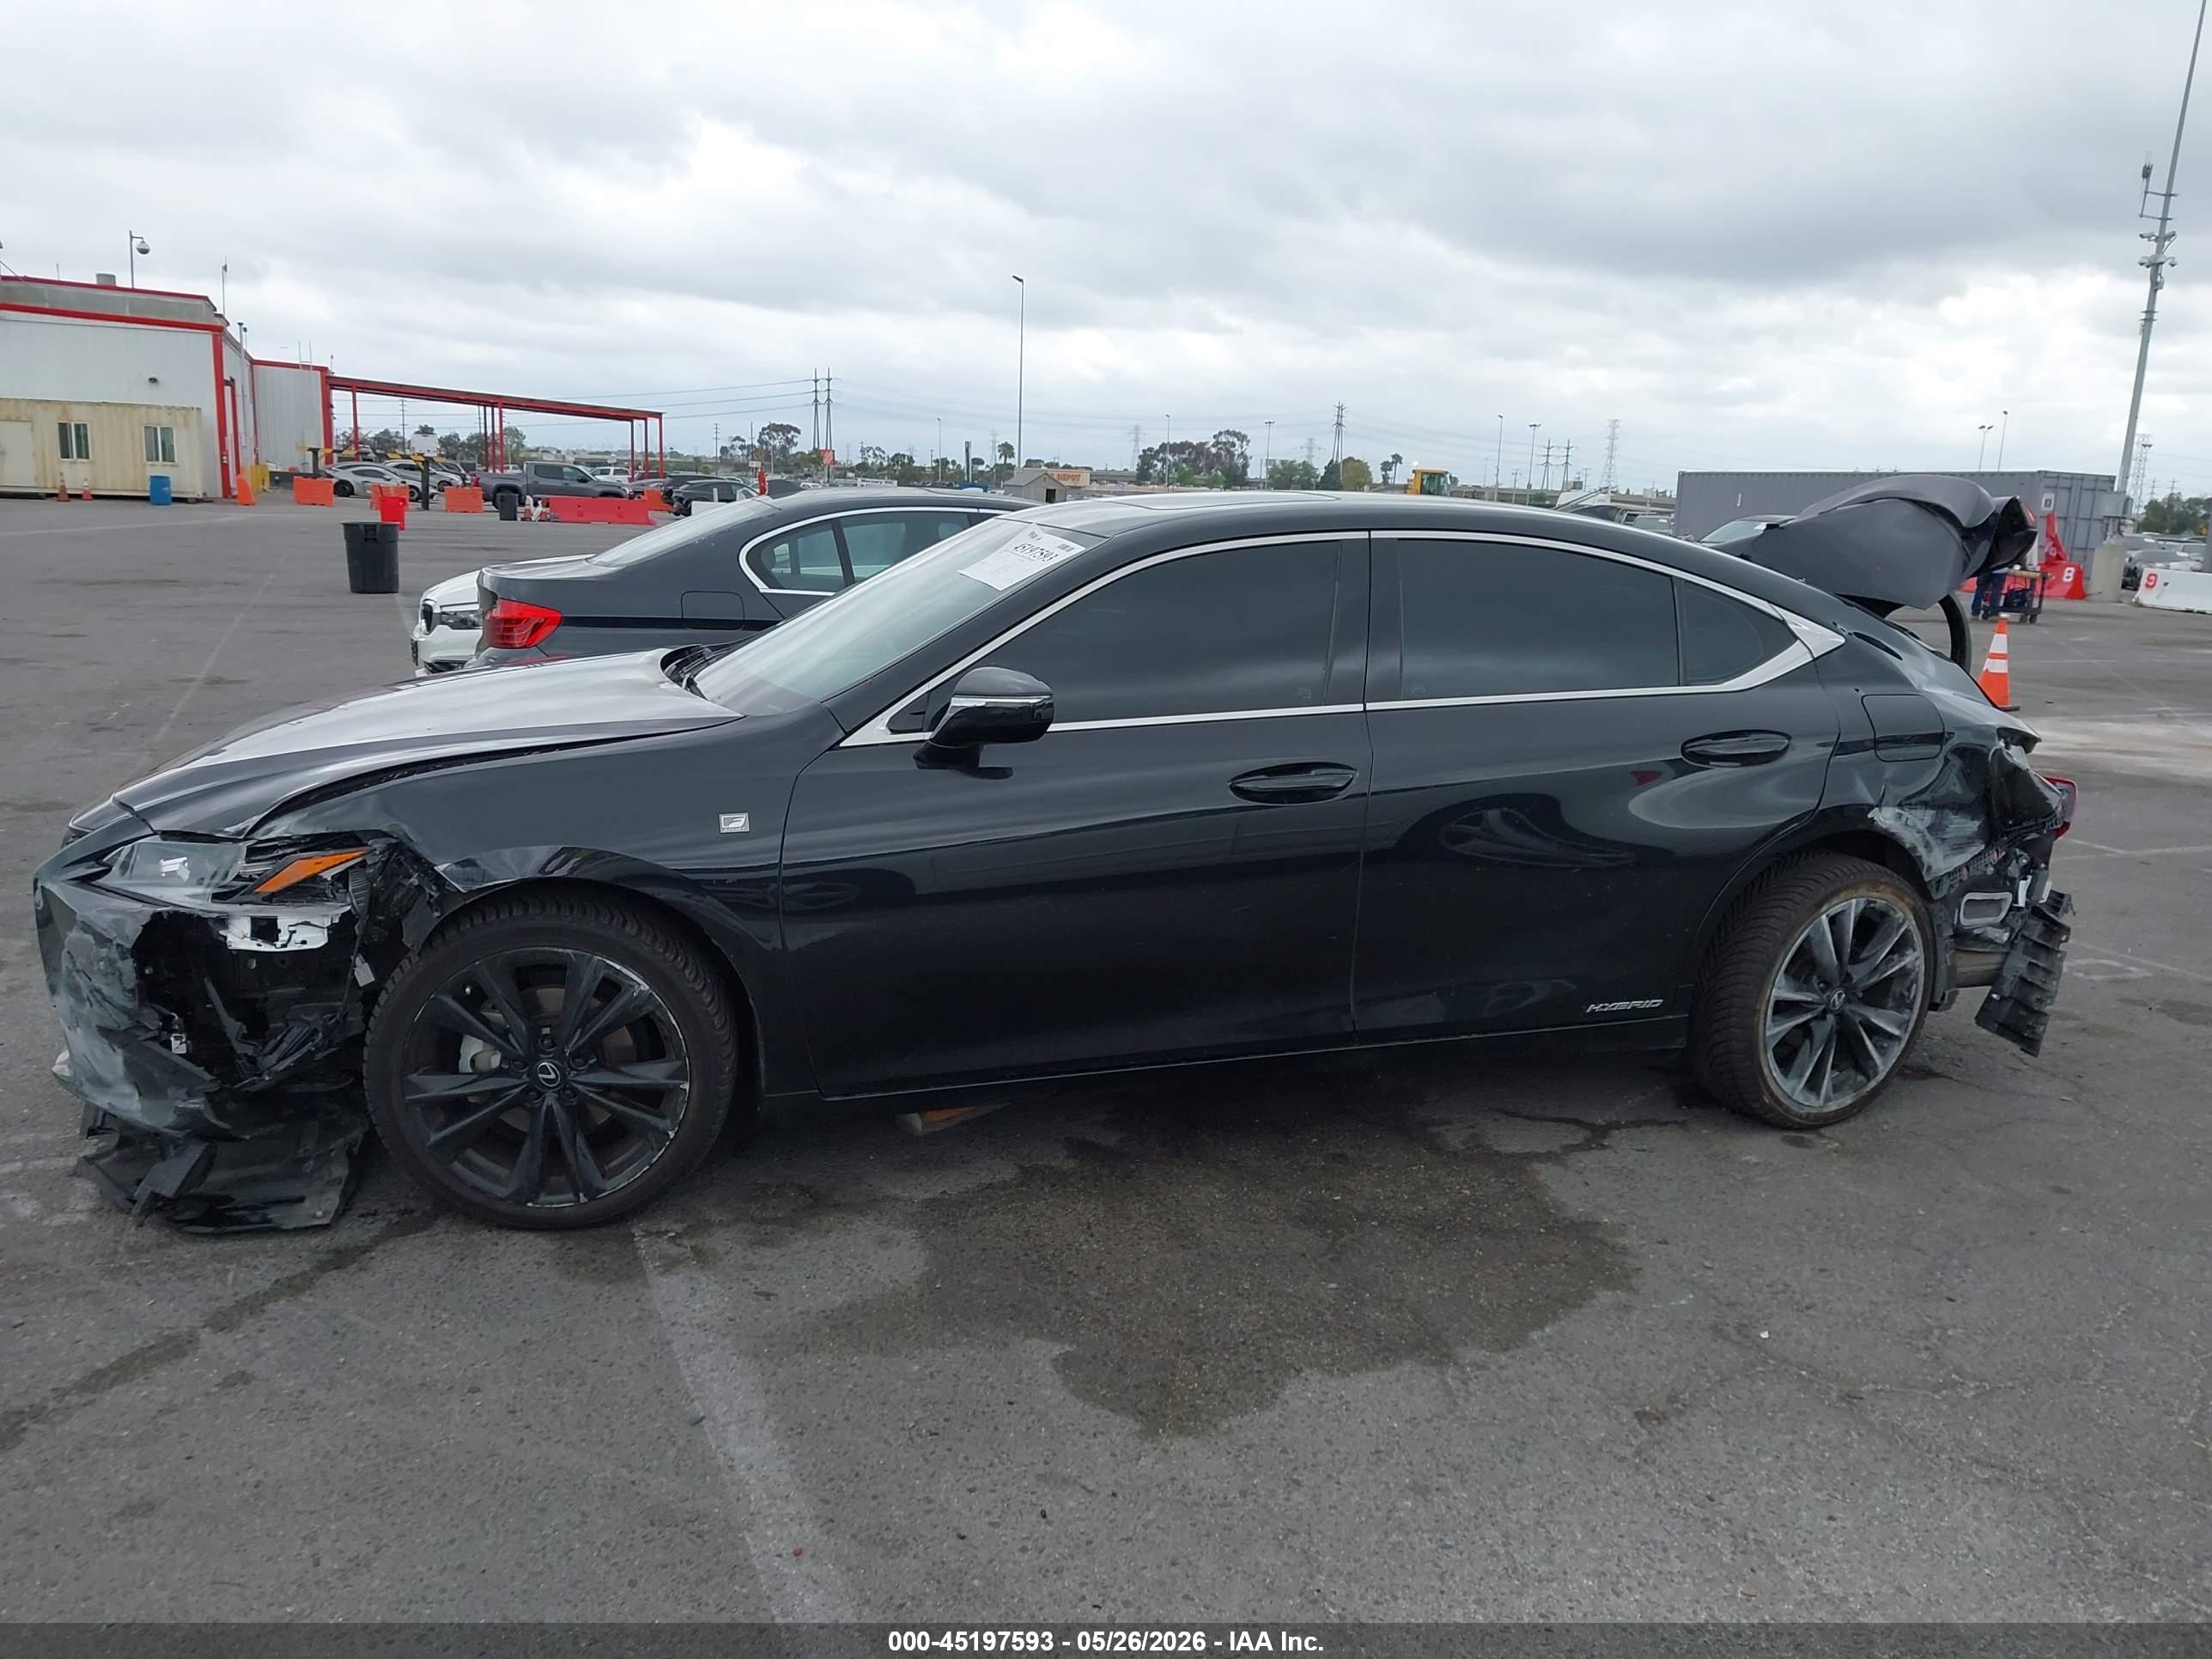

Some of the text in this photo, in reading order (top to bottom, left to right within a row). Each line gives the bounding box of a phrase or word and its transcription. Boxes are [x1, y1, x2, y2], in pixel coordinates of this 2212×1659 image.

[2063, 567, 2075, 582] 8
[2145, 573, 2158, 589] 9
[1586, 999, 1664, 1013] HYBRID
